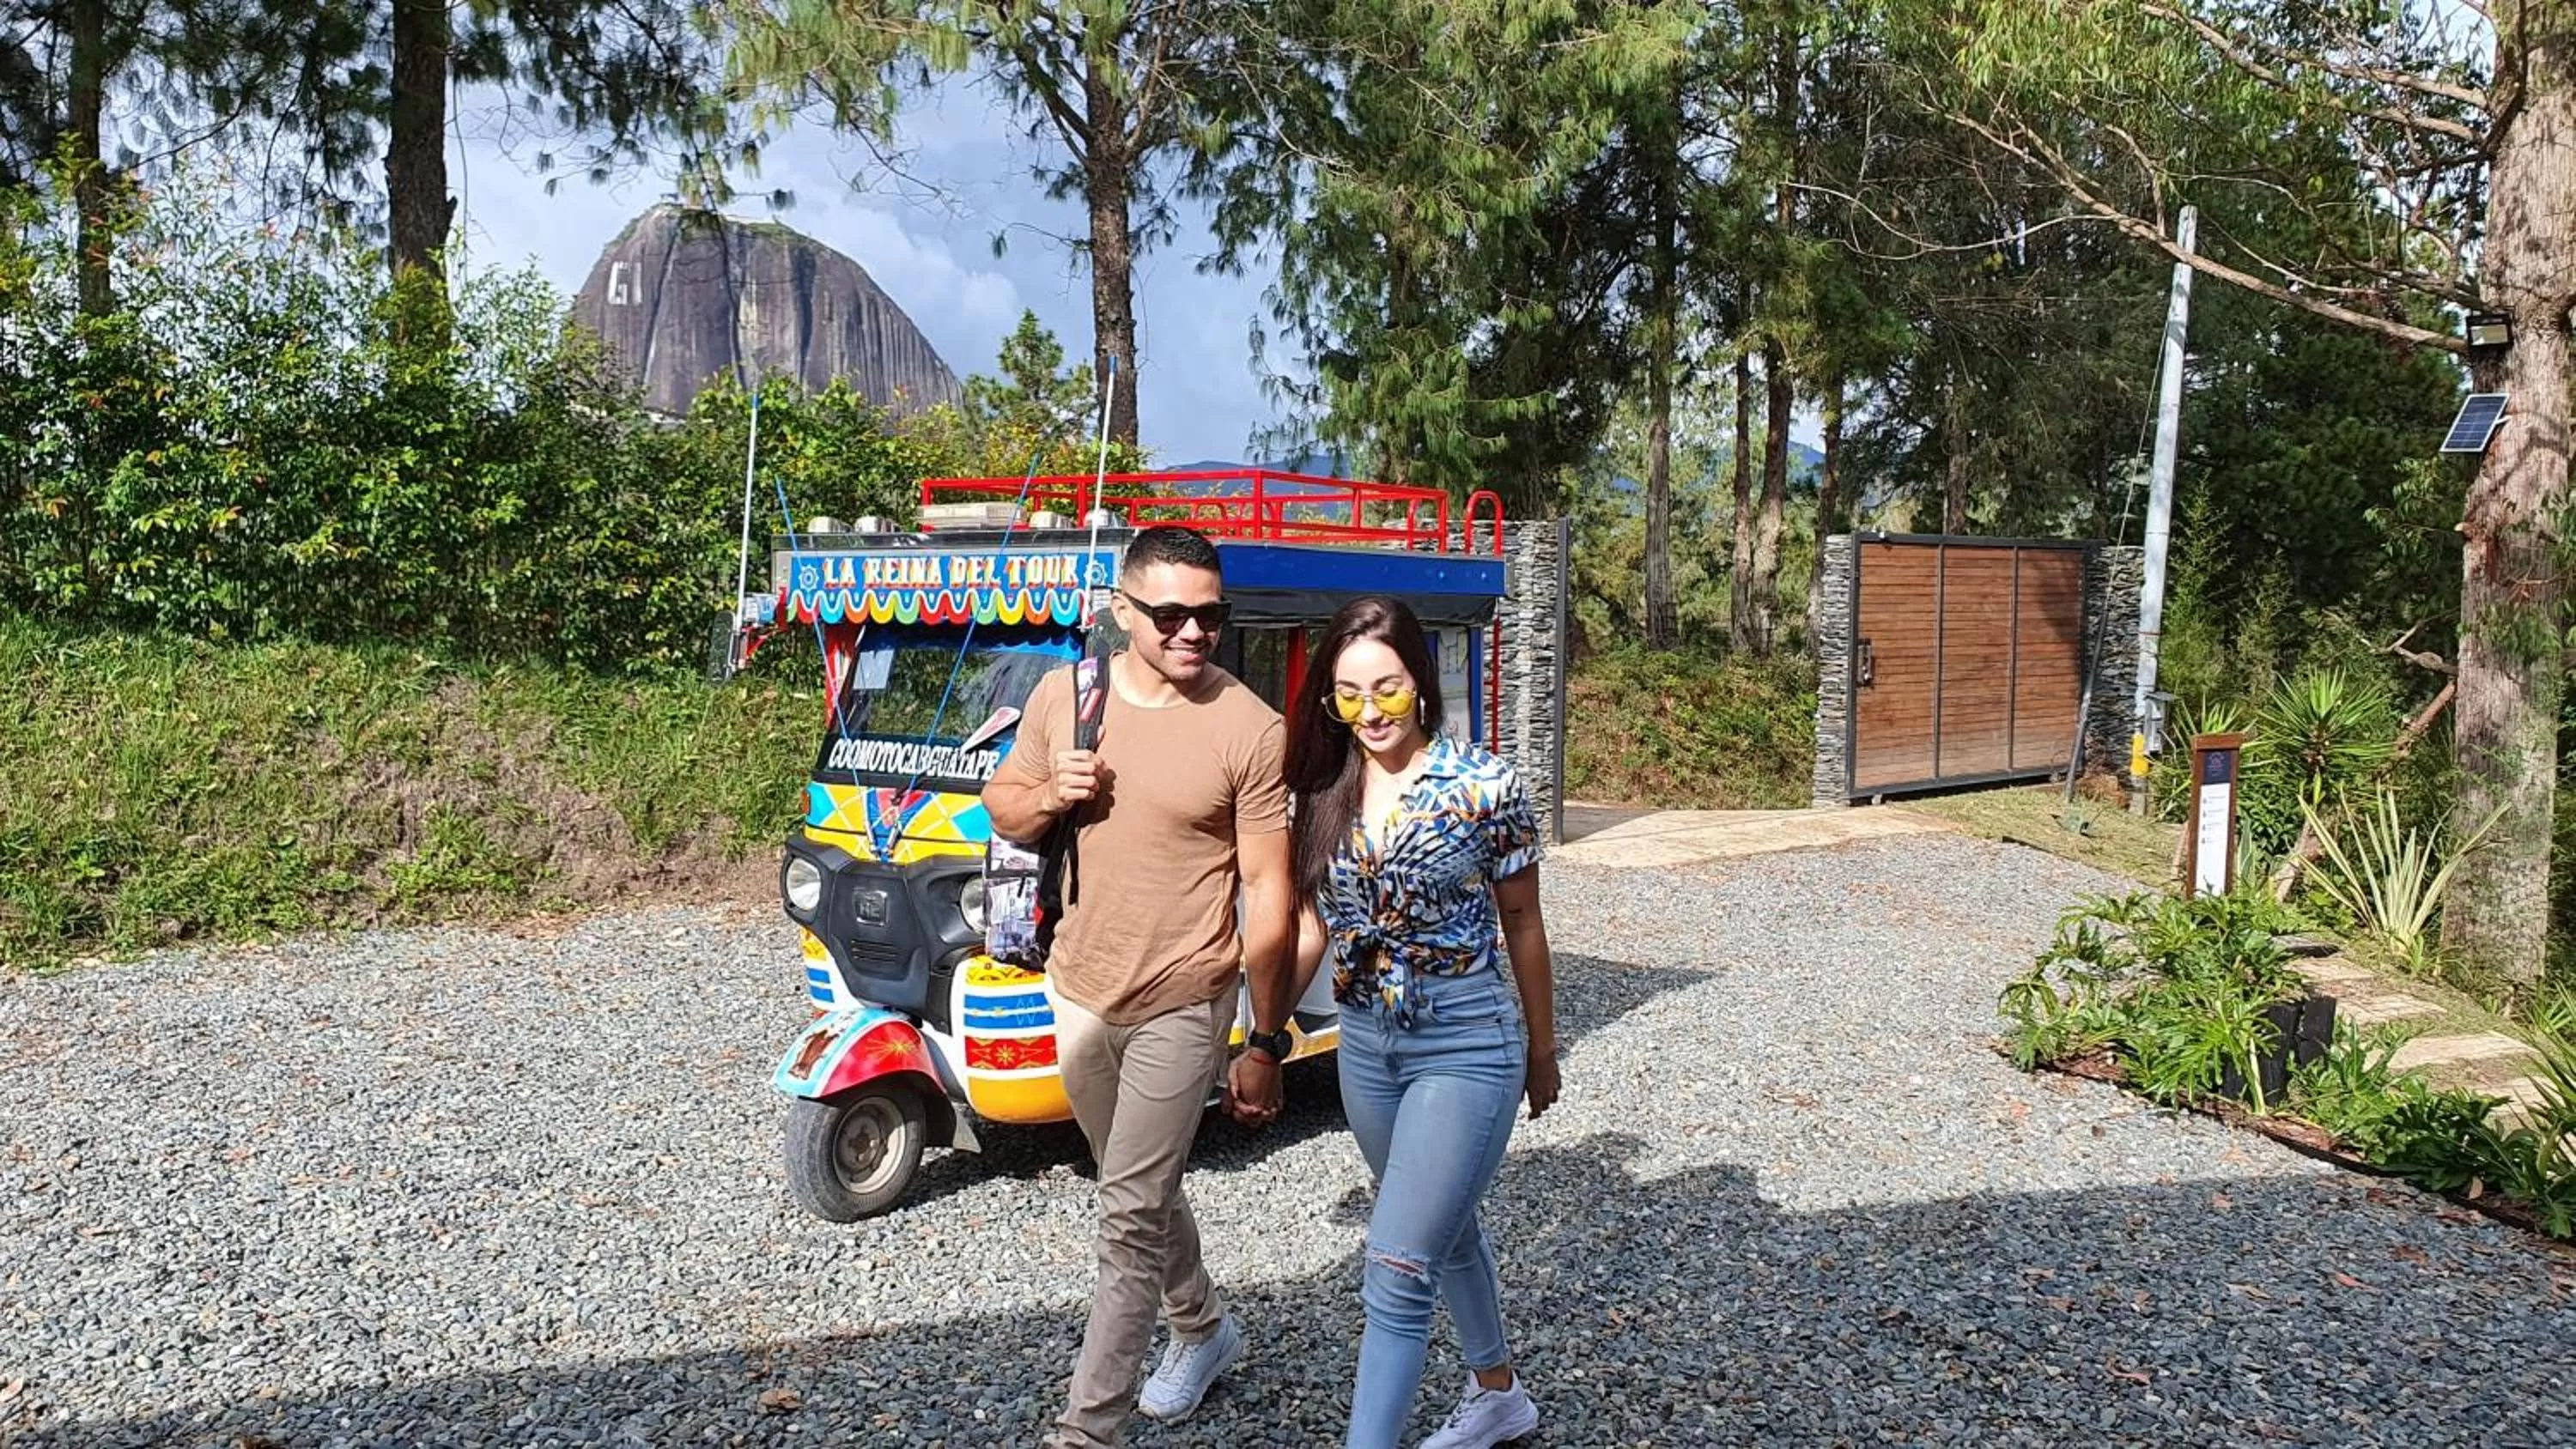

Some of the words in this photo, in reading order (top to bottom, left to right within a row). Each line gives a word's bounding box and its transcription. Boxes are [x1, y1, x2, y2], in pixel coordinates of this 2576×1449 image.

[823, 556, 857, 588] LA
[862, 556, 943, 588] REINA
[949, 556, 1002, 588] DEL
[1005, 555, 1079, 588] TOUR
